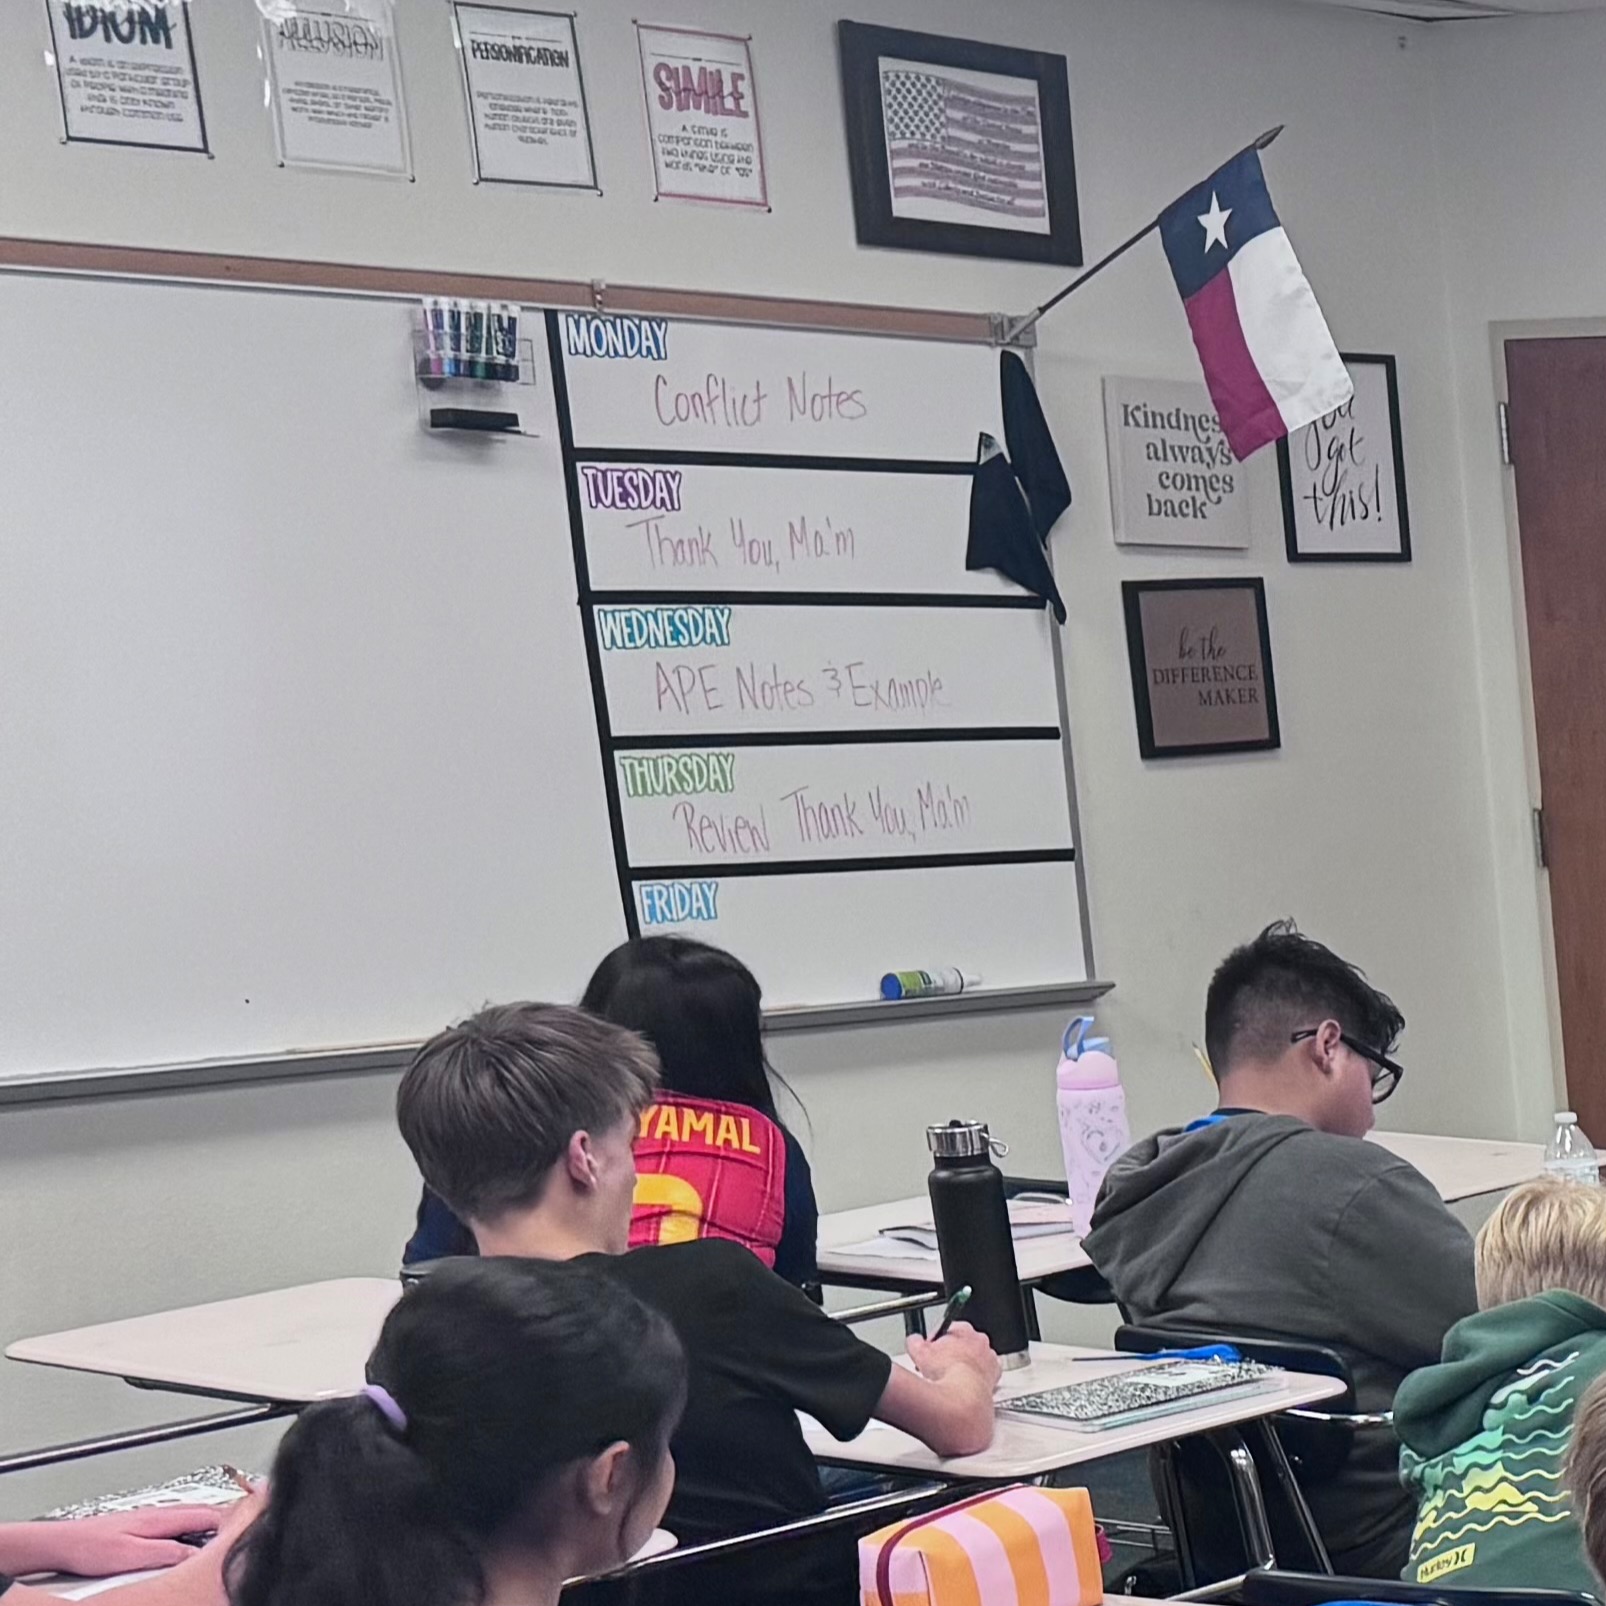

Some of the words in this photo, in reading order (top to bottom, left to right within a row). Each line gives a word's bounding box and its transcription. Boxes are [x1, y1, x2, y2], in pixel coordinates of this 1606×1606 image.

[470, 39, 570, 68] PERSONIFICATION
[653, 62, 749, 118] SIMILE
[566, 313, 668, 360] MONDAY
[655, 374, 767, 427] Conflict
[786, 374, 868, 423] Notes
[1121, 401, 1221, 444] Kindnes
[1146, 438, 1233, 470] always
[1321, 427, 1365, 497] got
[581, 466, 681, 510] TUESDAY
[1146, 493, 1208, 519] back
[1158, 471, 1235, 504] comes
[1303, 463, 1382, 531] this!
[626, 516, 715, 570] Thank
[731, 517, 781, 575] You,
[598, 607, 733, 650] WEDNESDAY
[1178, 626, 1197, 660] be
[1199, 628, 1227, 660] the
[654, 661, 724, 714] APE
[736, 663, 814, 712] Notes
[846, 661, 945, 711] Example
[1153, 664, 1258, 686] DIFFERENCE
[1198, 688, 1260, 707] MAKER
[620, 752, 735, 798] THURSDAY
[672, 801, 771, 855] Review
[780, 785, 864, 845] Thank
[639, 881, 720, 924] FRIDAY
[638, 1105, 761, 1154] YAMAL
